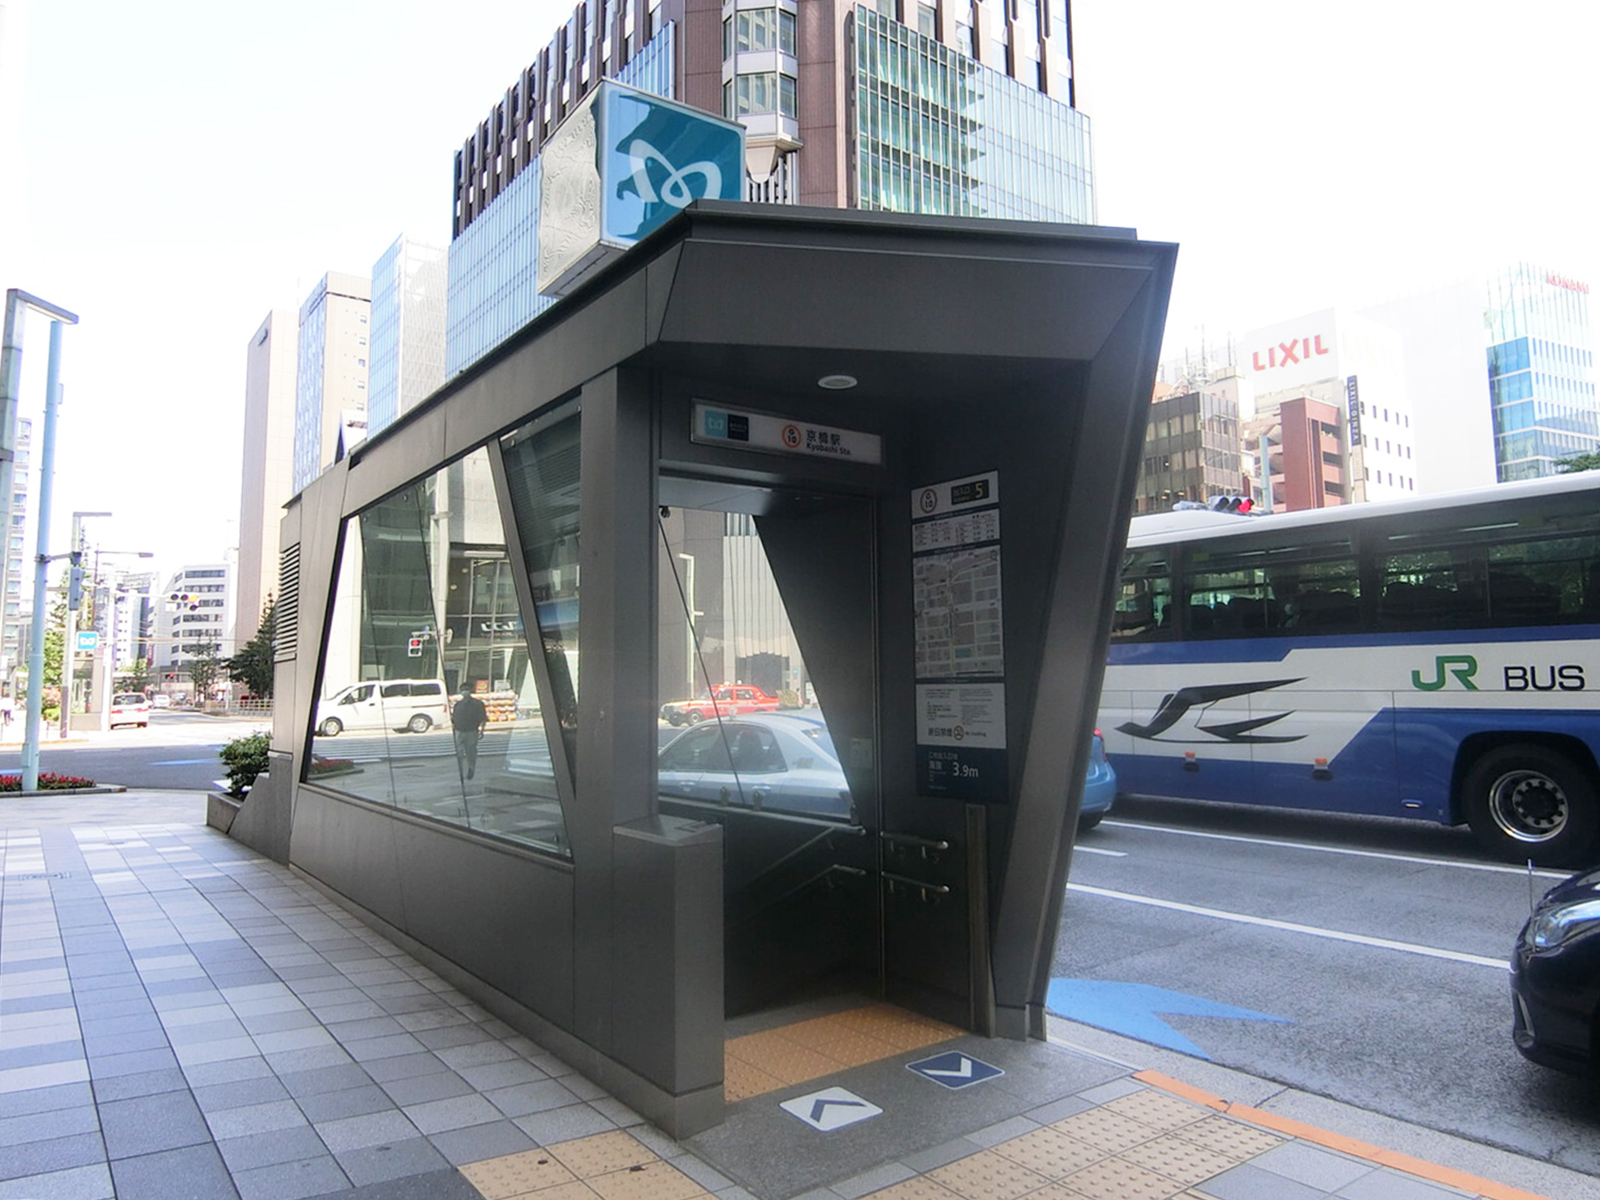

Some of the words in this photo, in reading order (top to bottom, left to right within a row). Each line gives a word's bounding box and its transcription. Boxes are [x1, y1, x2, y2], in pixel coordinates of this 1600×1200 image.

[1546, 272, 1589, 295] KONAMI
[1252, 333, 1329, 372] LIXIL
[806, 429, 841, 446] 京橋駅
[806, 442, 838, 453] Kyobashi
[975, 482, 984, 499] 5
[925, 500, 933, 509] 10
[1411, 654, 1480, 692] JR
[1504, 665, 1586, 692] BUS
[952, 761, 979, 779] 3.9m
